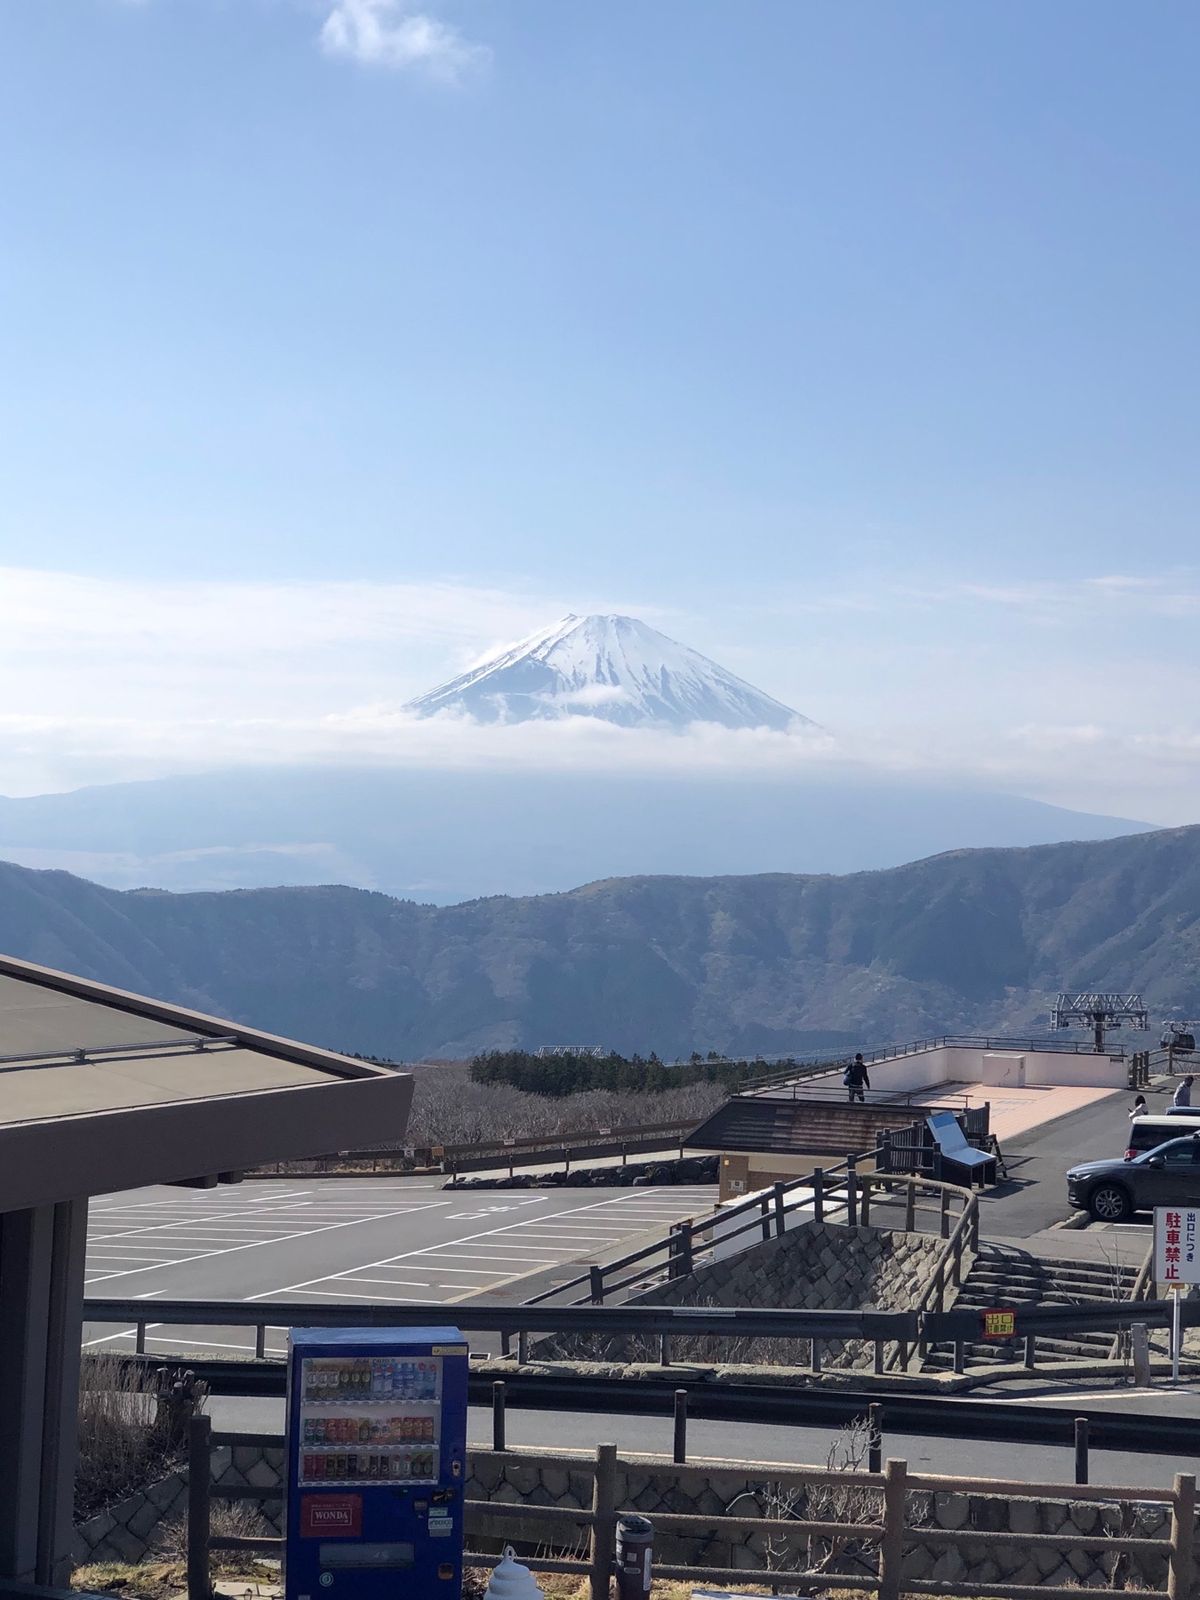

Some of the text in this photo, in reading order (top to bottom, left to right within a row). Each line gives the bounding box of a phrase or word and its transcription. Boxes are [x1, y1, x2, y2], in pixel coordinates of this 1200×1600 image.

[1165, 1212, 1181, 1280] 駐車禁止
[1186, 1212, 1196, 1262] 出口につき
[986, 1314, 1013, 1324] 出口
[314, 1511, 349, 1520] WONDA
